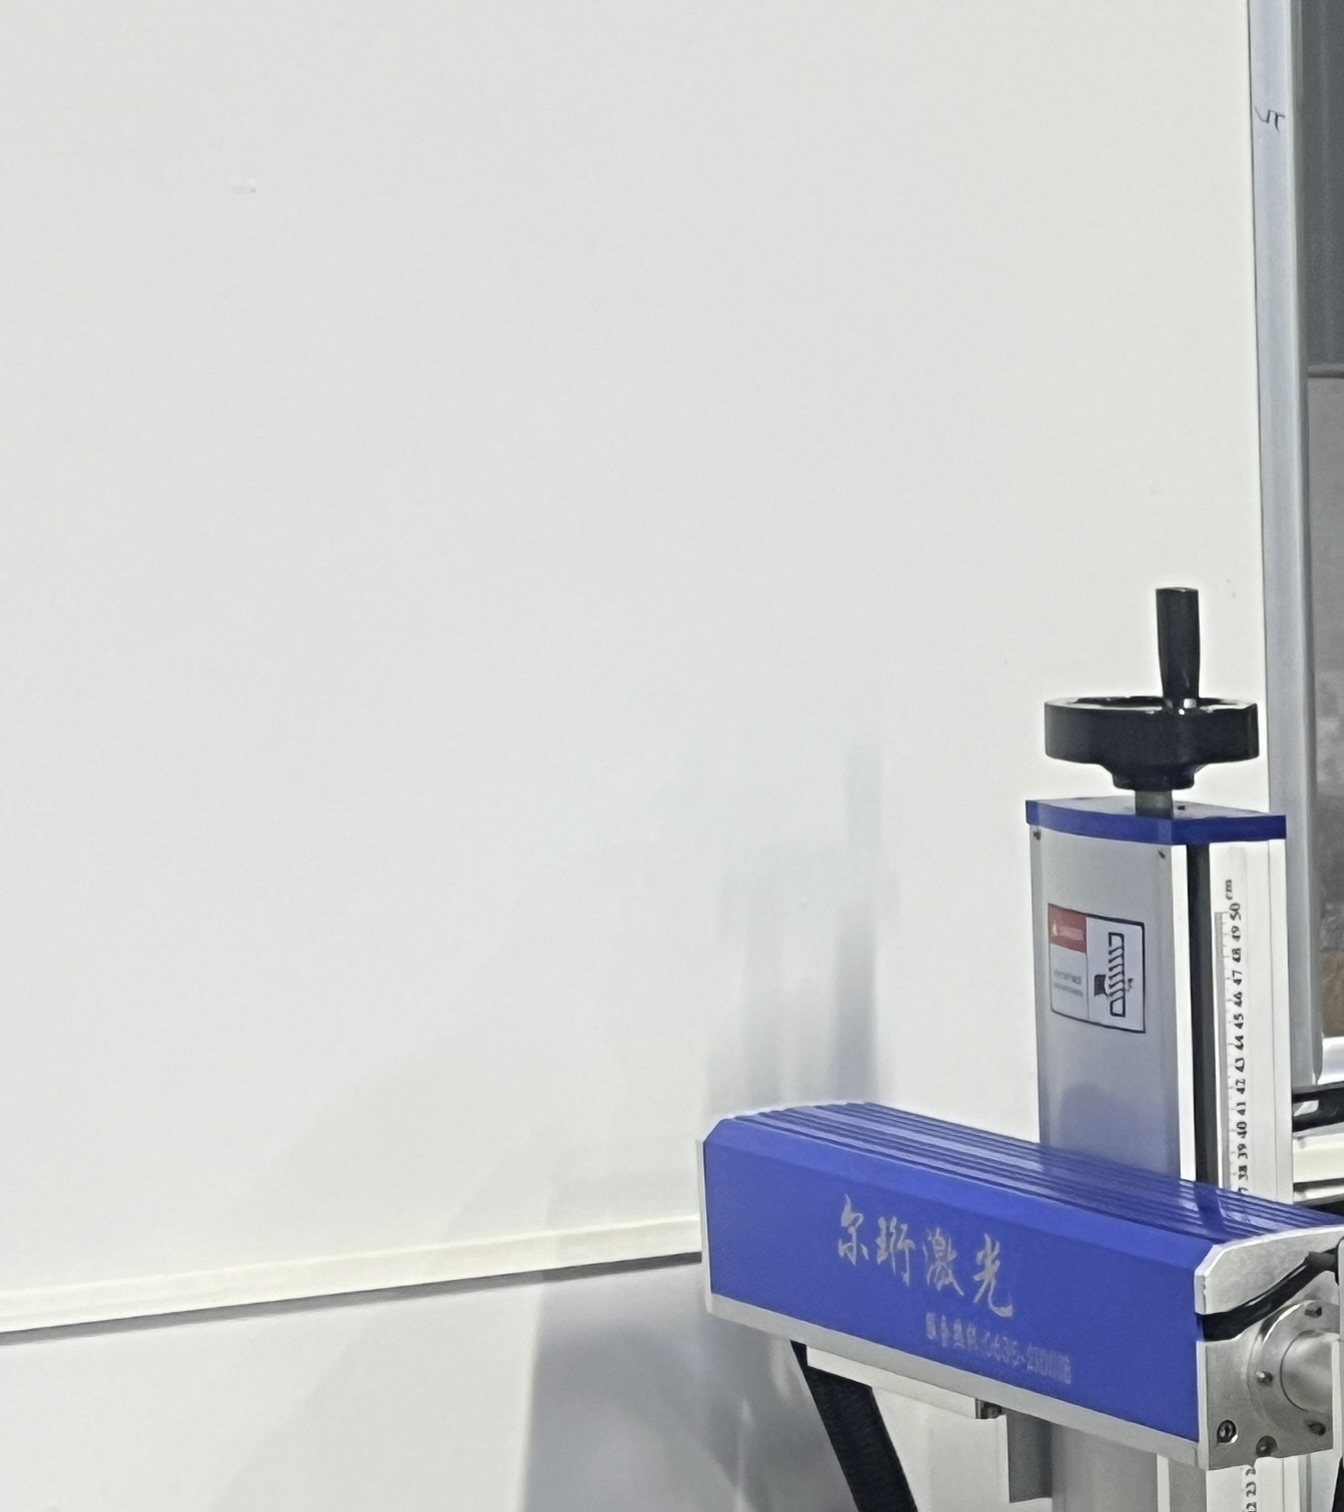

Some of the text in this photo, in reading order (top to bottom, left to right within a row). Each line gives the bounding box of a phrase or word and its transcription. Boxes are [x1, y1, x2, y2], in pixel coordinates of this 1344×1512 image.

[1230, 903, 1240, 921] 50
[1232, 926, 1241, 941] 49
[1233, 971, 1242, 985] 47
[1234, 1014, 1244, 1029] 45
[1236, 1080, 1245, 1094] 42
[1237, 1102, 1246, 1115] 41
[1238, 1122, 1247, 1138] 40
[1238, 1144, 1248, 1158] 39
[1246, 1483, 1256, 1497] 23
